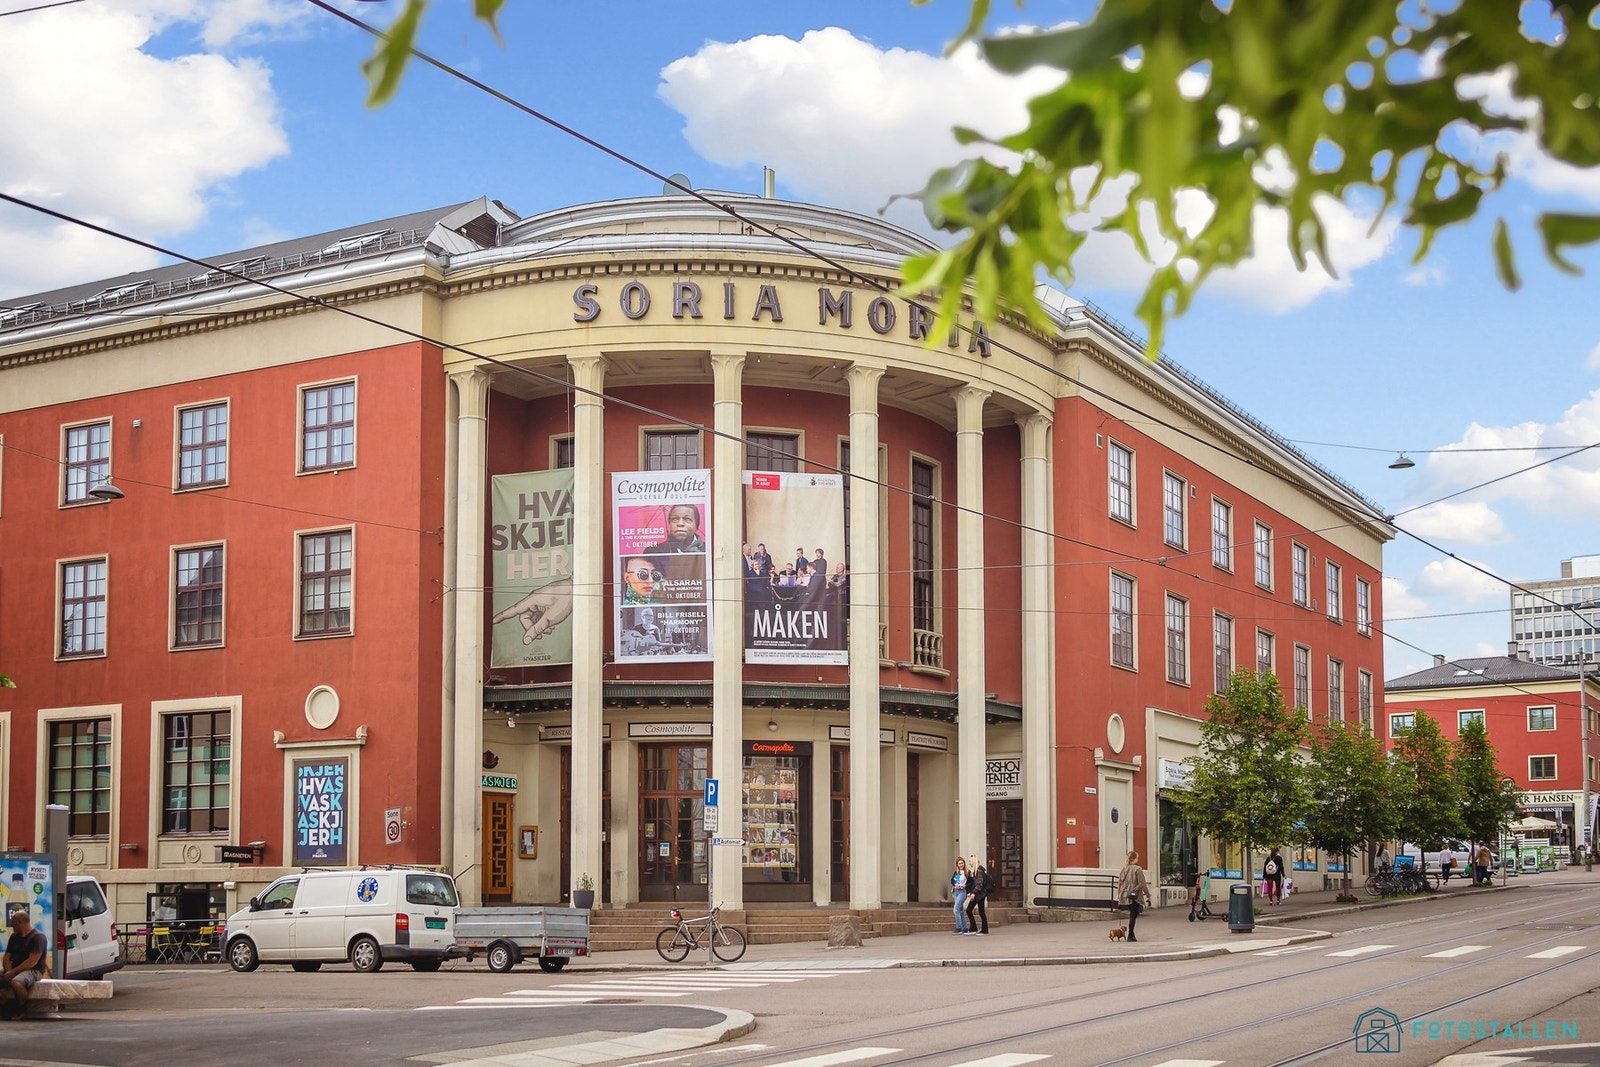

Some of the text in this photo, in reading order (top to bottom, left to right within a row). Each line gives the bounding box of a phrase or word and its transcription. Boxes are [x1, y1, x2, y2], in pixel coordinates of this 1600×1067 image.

[573, 280, 993, 358] SORIA MORIA
[617, 475, 706, 499] Cosmopolite
[518, 489, 574, 520] HVA
[637, 527, 665, 535] FIELDS
[507, 549, 569, 580] HER
[663, 579, 703, 587] ALSARAH
[753, 603, 828, 639] MÅKEN
[644, 724, 696, 734] Cosmopolite
[752, 742, 794, 755] Cosmopolite
[707, 782, 716, 803] P
[1533, 794, 1574, 803] HANSEN
[386, 810, 399, 818] Sone
[389, 825, 397, 837] 30
